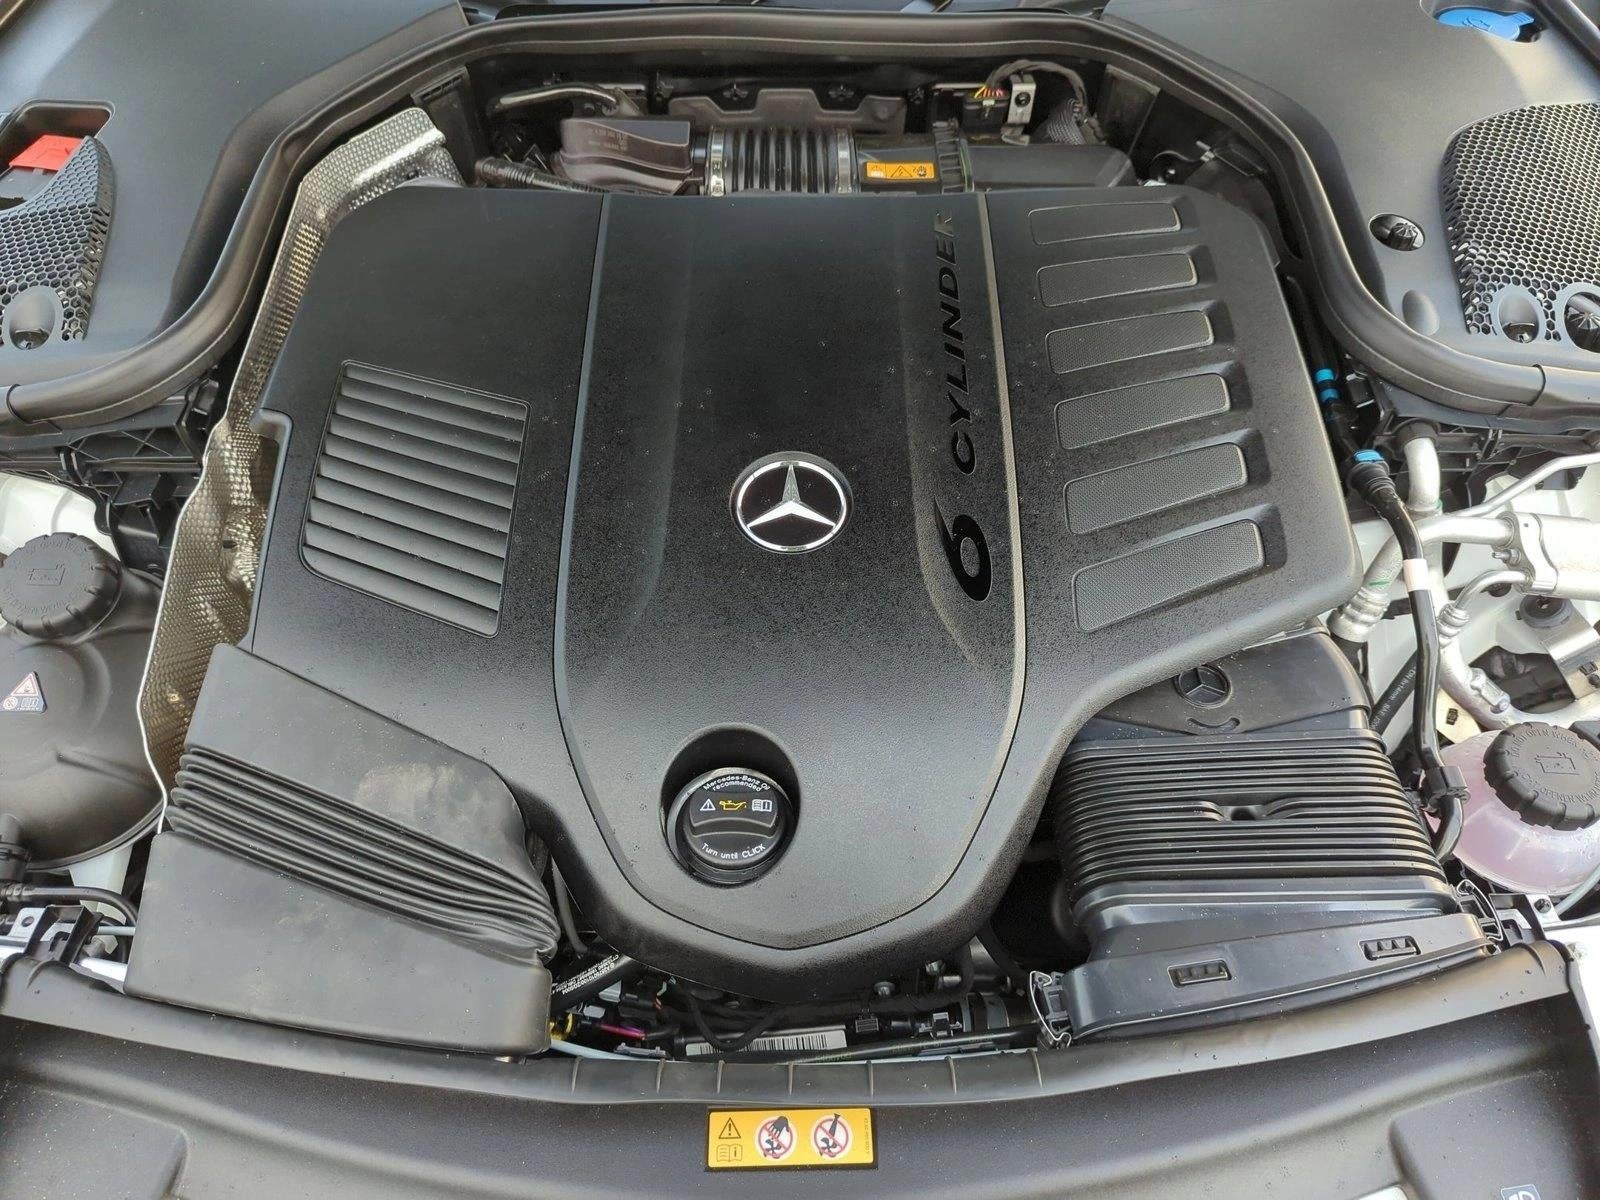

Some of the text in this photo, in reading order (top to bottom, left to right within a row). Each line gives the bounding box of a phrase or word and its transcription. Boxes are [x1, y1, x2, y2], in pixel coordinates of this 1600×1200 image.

[934, 207, 992, 602] 6 CYLINDER
[703, 774, 760, 791] Mercedes-Benz
[712, 780, 762, 792] recommended
[701, 842, 766, 859] Turn until CLICK
